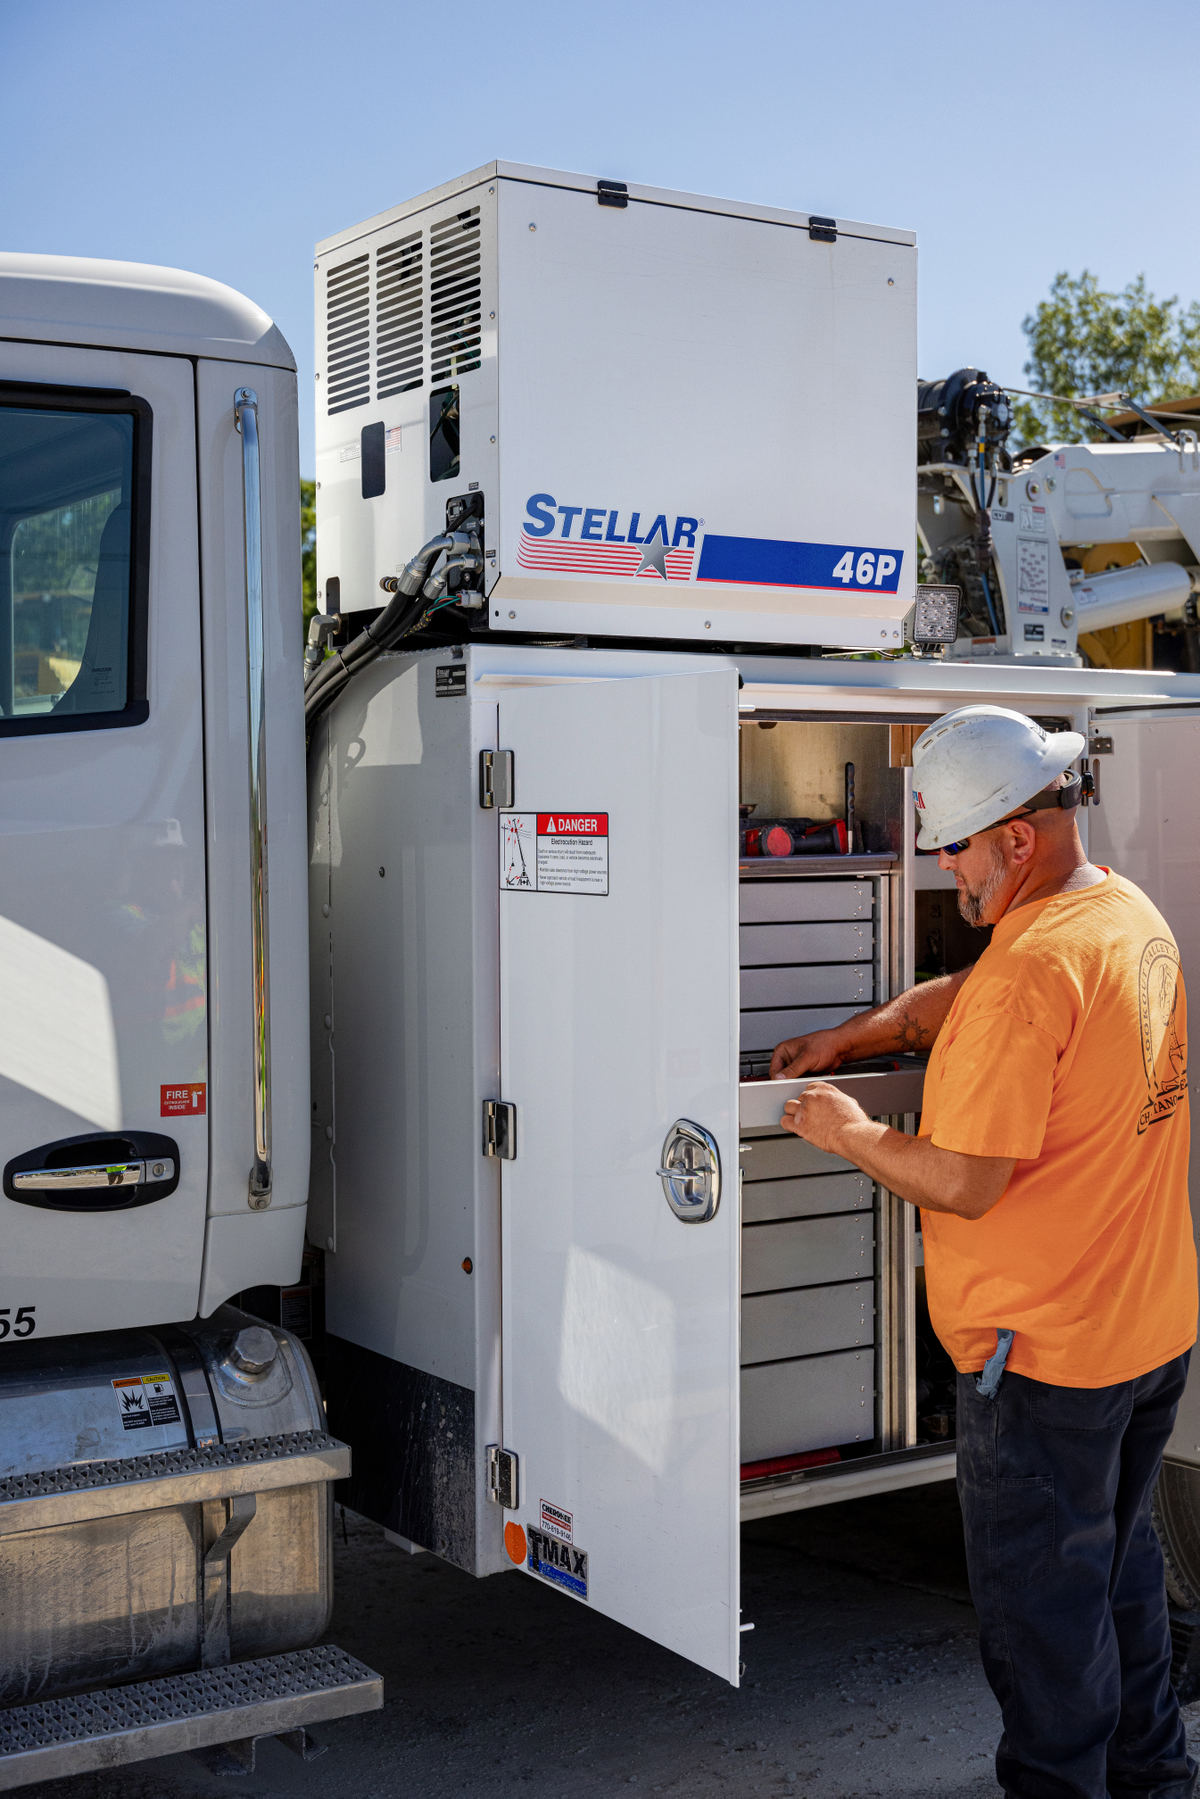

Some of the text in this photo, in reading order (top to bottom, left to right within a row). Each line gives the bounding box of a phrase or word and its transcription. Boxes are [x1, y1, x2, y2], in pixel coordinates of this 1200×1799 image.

[832, 551, 897, 585] 46P
[558, 818, 597, 832] DANGER
[551, 838, 577, 846] Electrocution
[1141, 943, 1170, 1063] LOOKOUT VALLEY
[166, 1090, 188, 1099] FIRE
[542, 1503, 572, 1524] CHEROKEE
[528, 1528, 586, 1580] TMAX
